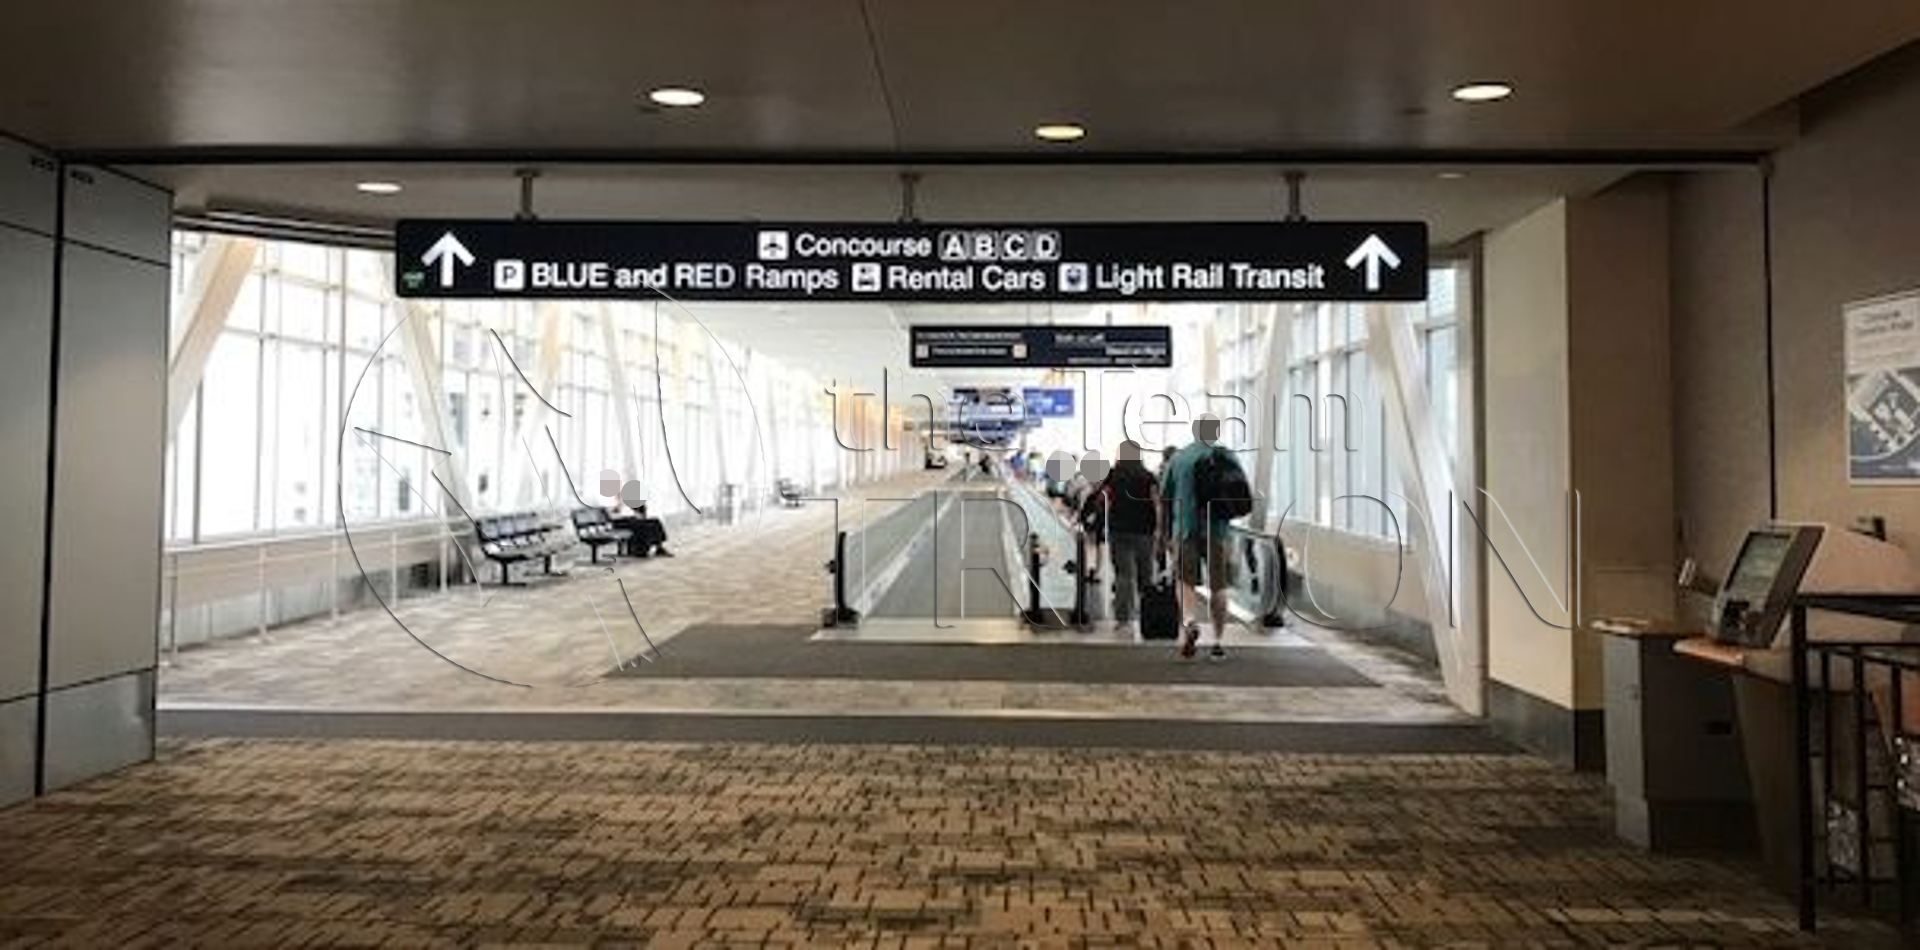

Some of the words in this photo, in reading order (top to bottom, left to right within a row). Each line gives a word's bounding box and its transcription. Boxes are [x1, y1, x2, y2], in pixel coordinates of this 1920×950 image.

[796, 233, 931, 256] Concourse
[531, 263, 609, 288] BLUE
[615, 263, 669, 288] and
[675, 263, 736, 288] RED
[746, 263, 840, 295] Ramps
[888, 263, 974, 289] Rental
[981, 263, 1046, 289] Cars
[1096, 263, 1165, 295] Light
[1171, 263, 1224, 289] Rail
[1229, 263, 1325, 289] Transit
